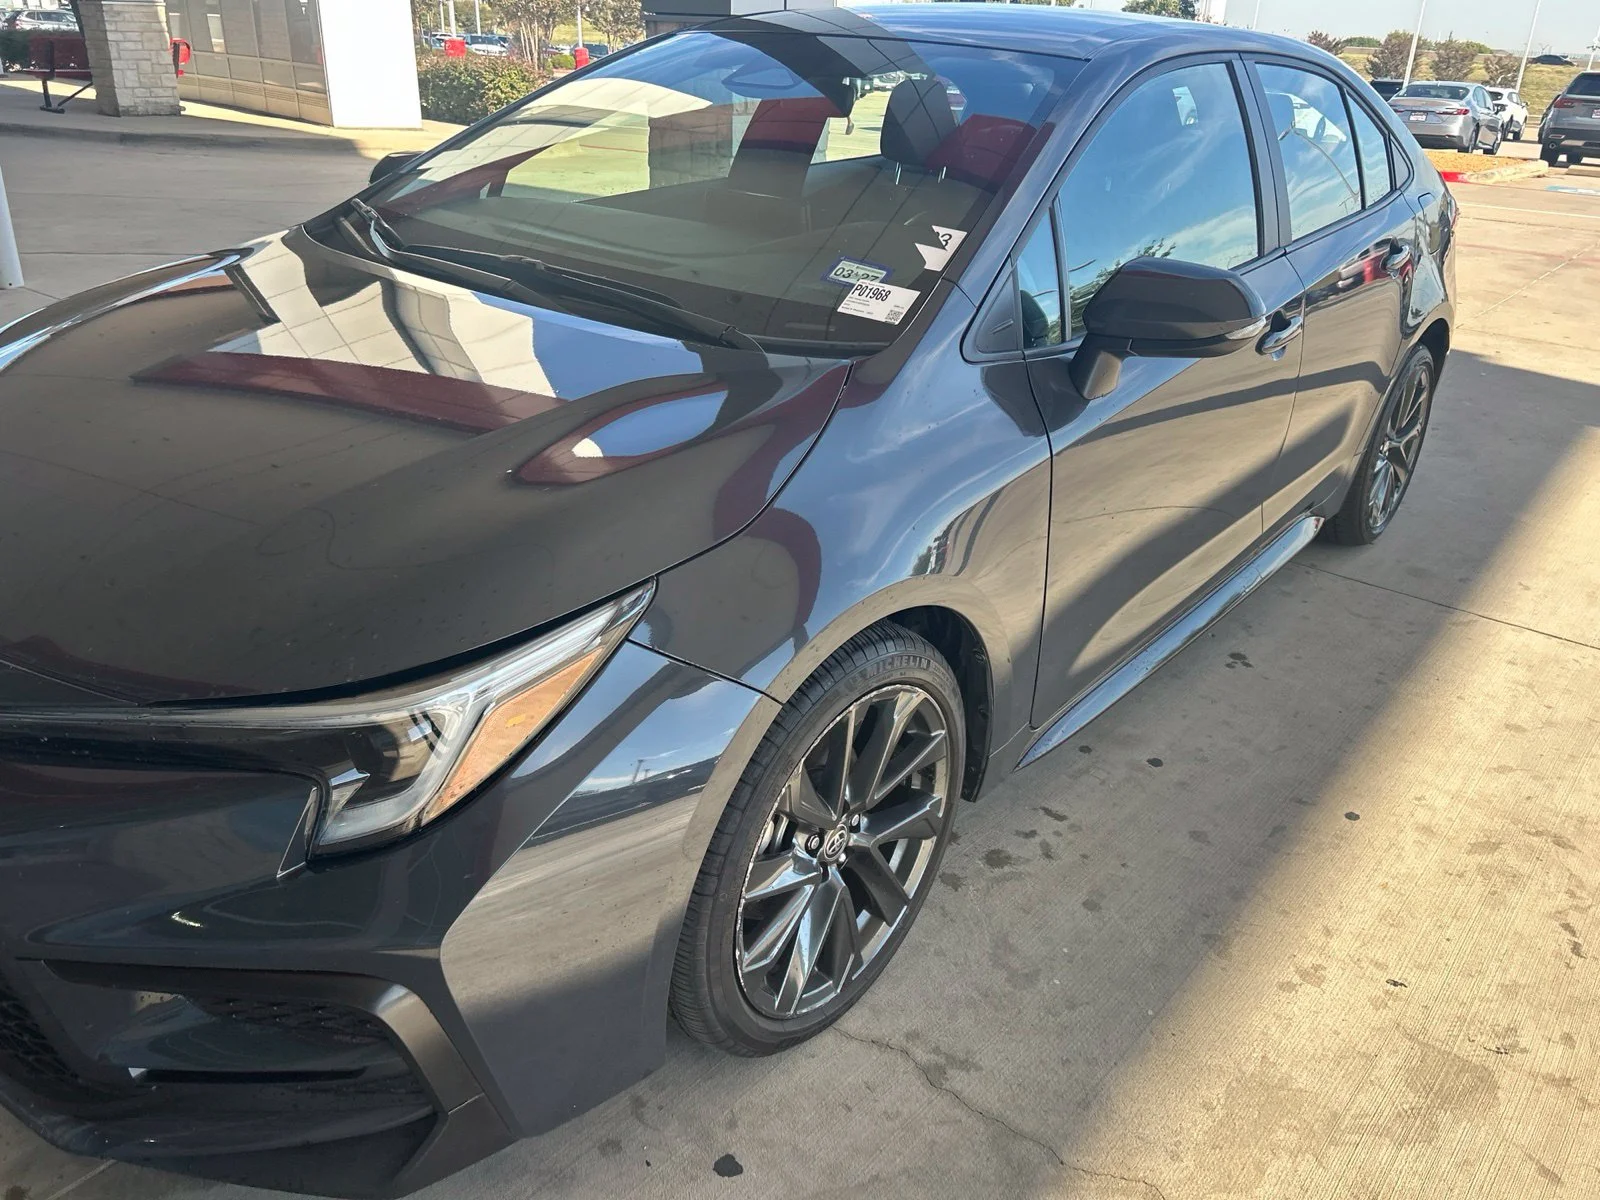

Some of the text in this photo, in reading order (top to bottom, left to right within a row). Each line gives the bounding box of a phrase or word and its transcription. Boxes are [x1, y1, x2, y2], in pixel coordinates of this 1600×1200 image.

[833, 266, 855, 279] 03
[851, 283, 892, 302] P01968
[866, 655, 928, 677] MICHELIN
